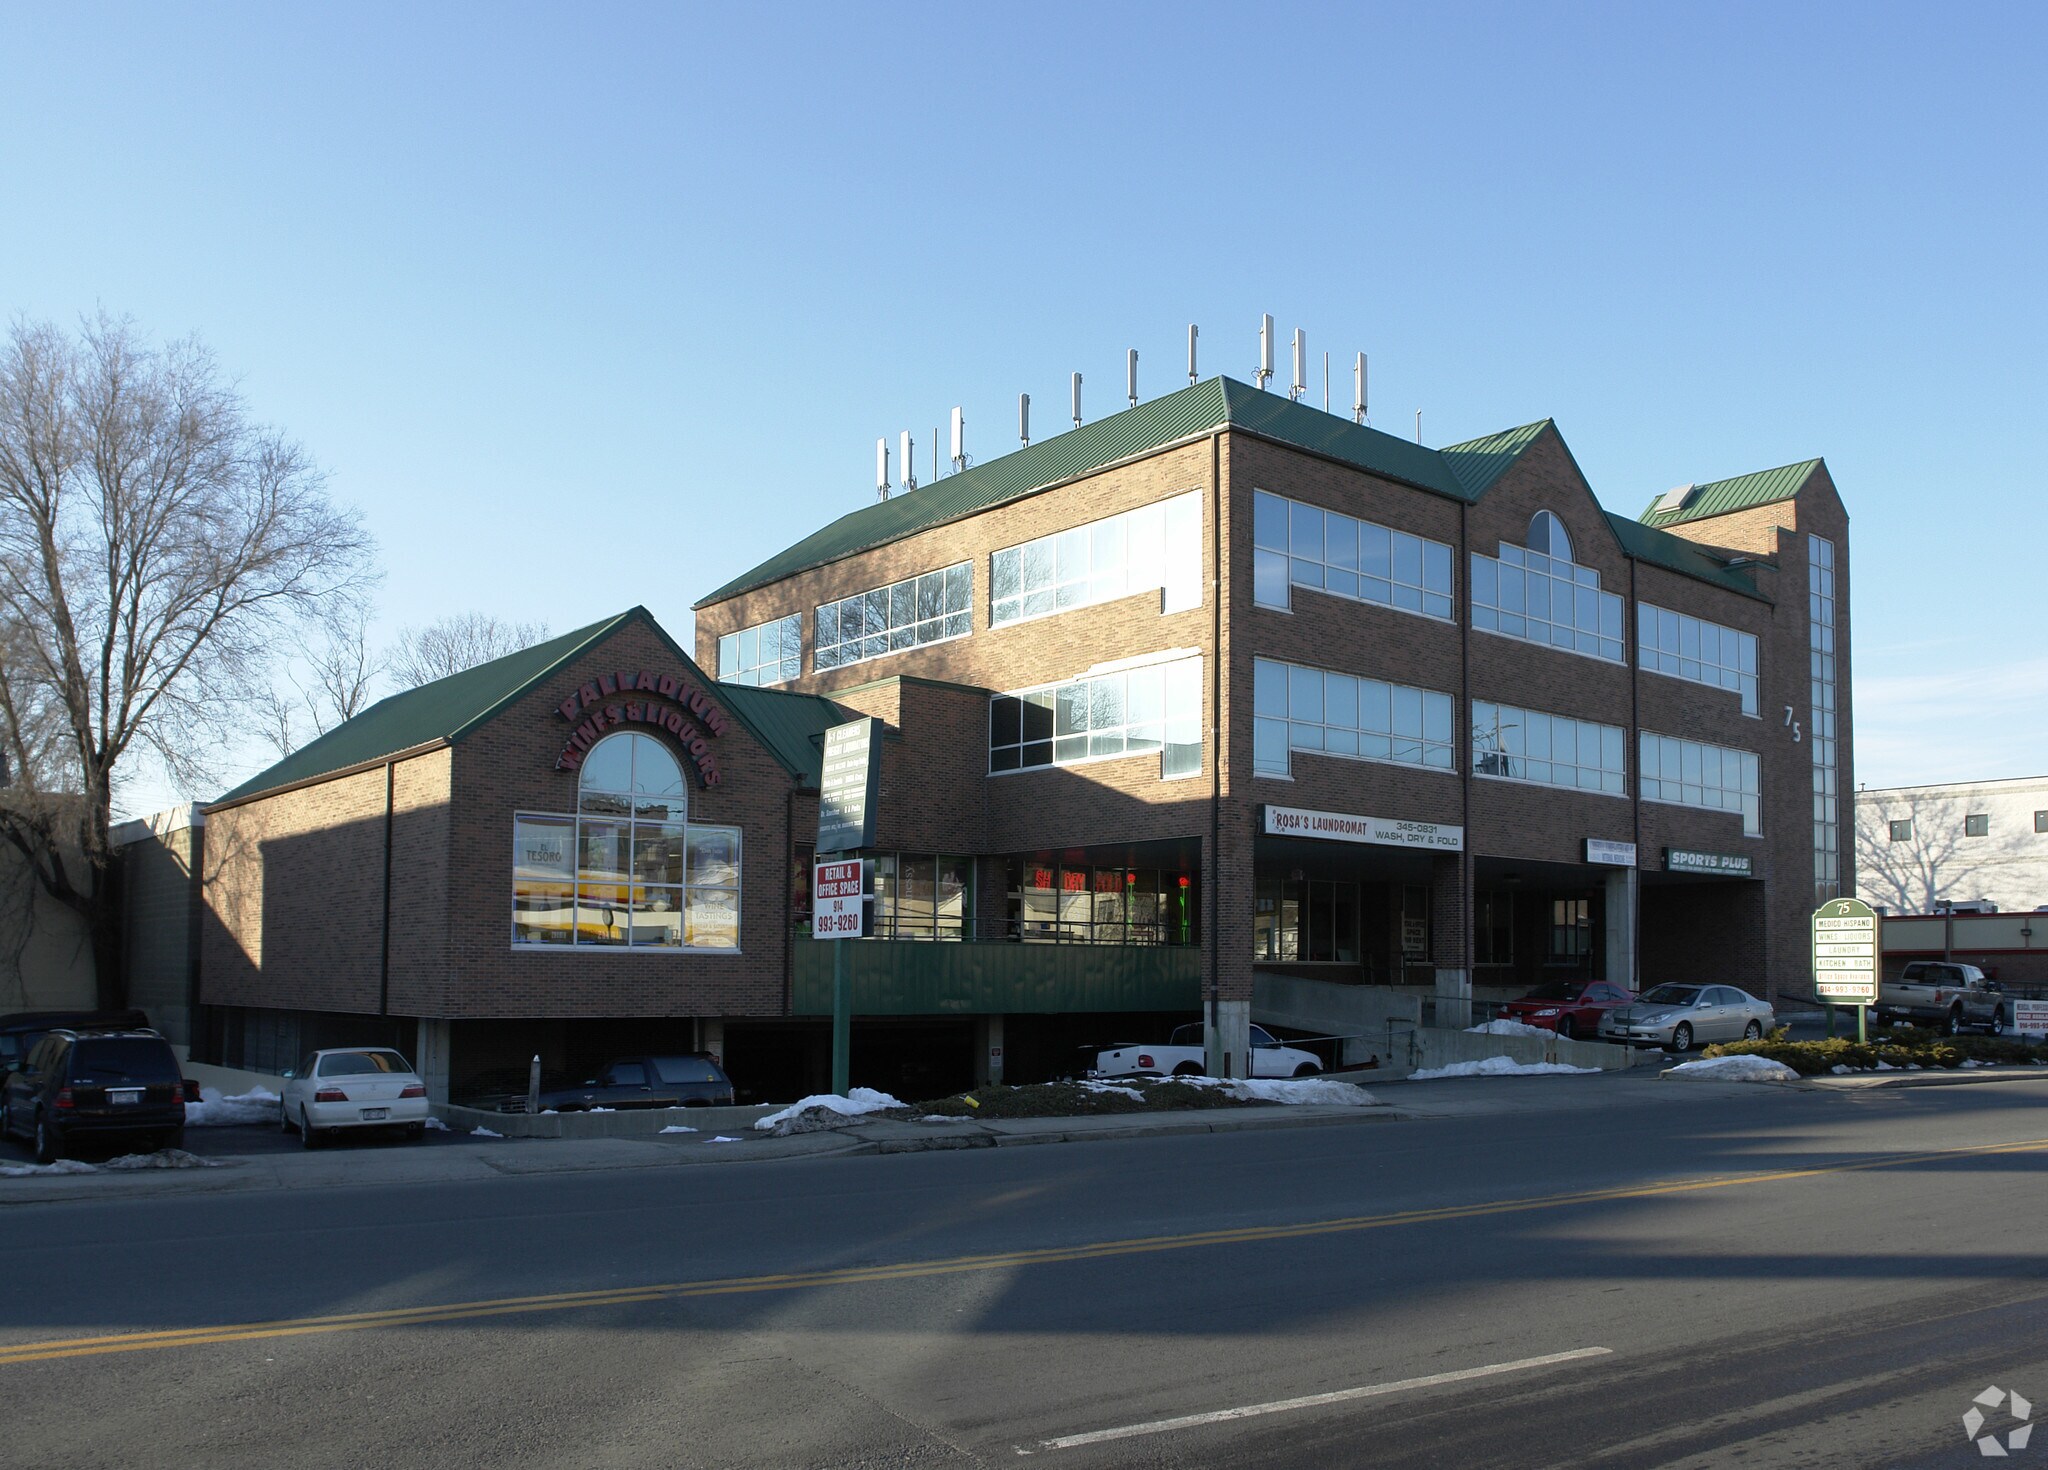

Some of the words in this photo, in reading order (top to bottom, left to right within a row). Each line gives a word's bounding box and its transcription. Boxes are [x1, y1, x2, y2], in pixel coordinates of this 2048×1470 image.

[558, 670, 730, 738] PALLADIUM
[559, 704, 621, 770] WINES
[645, 702, 721, 786] LIQUORS
[1276, 813, 1309, 830] ROSA'S
[1312, 817, 1367, 836] LAUNDROMAT
[1396, 822, 1438, 834] 345-0831
[1375, 831, 1405, 843] WASH,
[1407, 834, 1425, 843] DRY
[1428, 836, 1434, 844] &
[1437, 837, 1458, 846] FOLD
[526, 850, 562, 862] TESORO
[1672, 852, 1718, 867] SPORTS
[1722, 856, 1749, 869] PLUS
[825, 866, 845, 881] RETAIL
[847, 865, 852, 879] &
[818, 882, 838, 897] OFFICE
[840, 880, 859, 895] SPACE
[1063, 872, 1086, 892] DRY
[833, 900, 843, 913] 914
[1836, 902, 1850, 915] 75
[695, 912, 734, 921] TASTINGS
[818, 914, 858, 932] 993-9260
[1818, 920, 1841, 929] MEDICO
[1843, 919, 1871, 928] HISPANO
[1818, 932, 1838, 940] WINES
[1844, 932, 1871, 940] LIQUORS
[1828, 946, 1860, 954] LAUNDRY
[1819, 959, 1846, 967] KITCHEN
[1854, 959, 1871, 967] BATH
